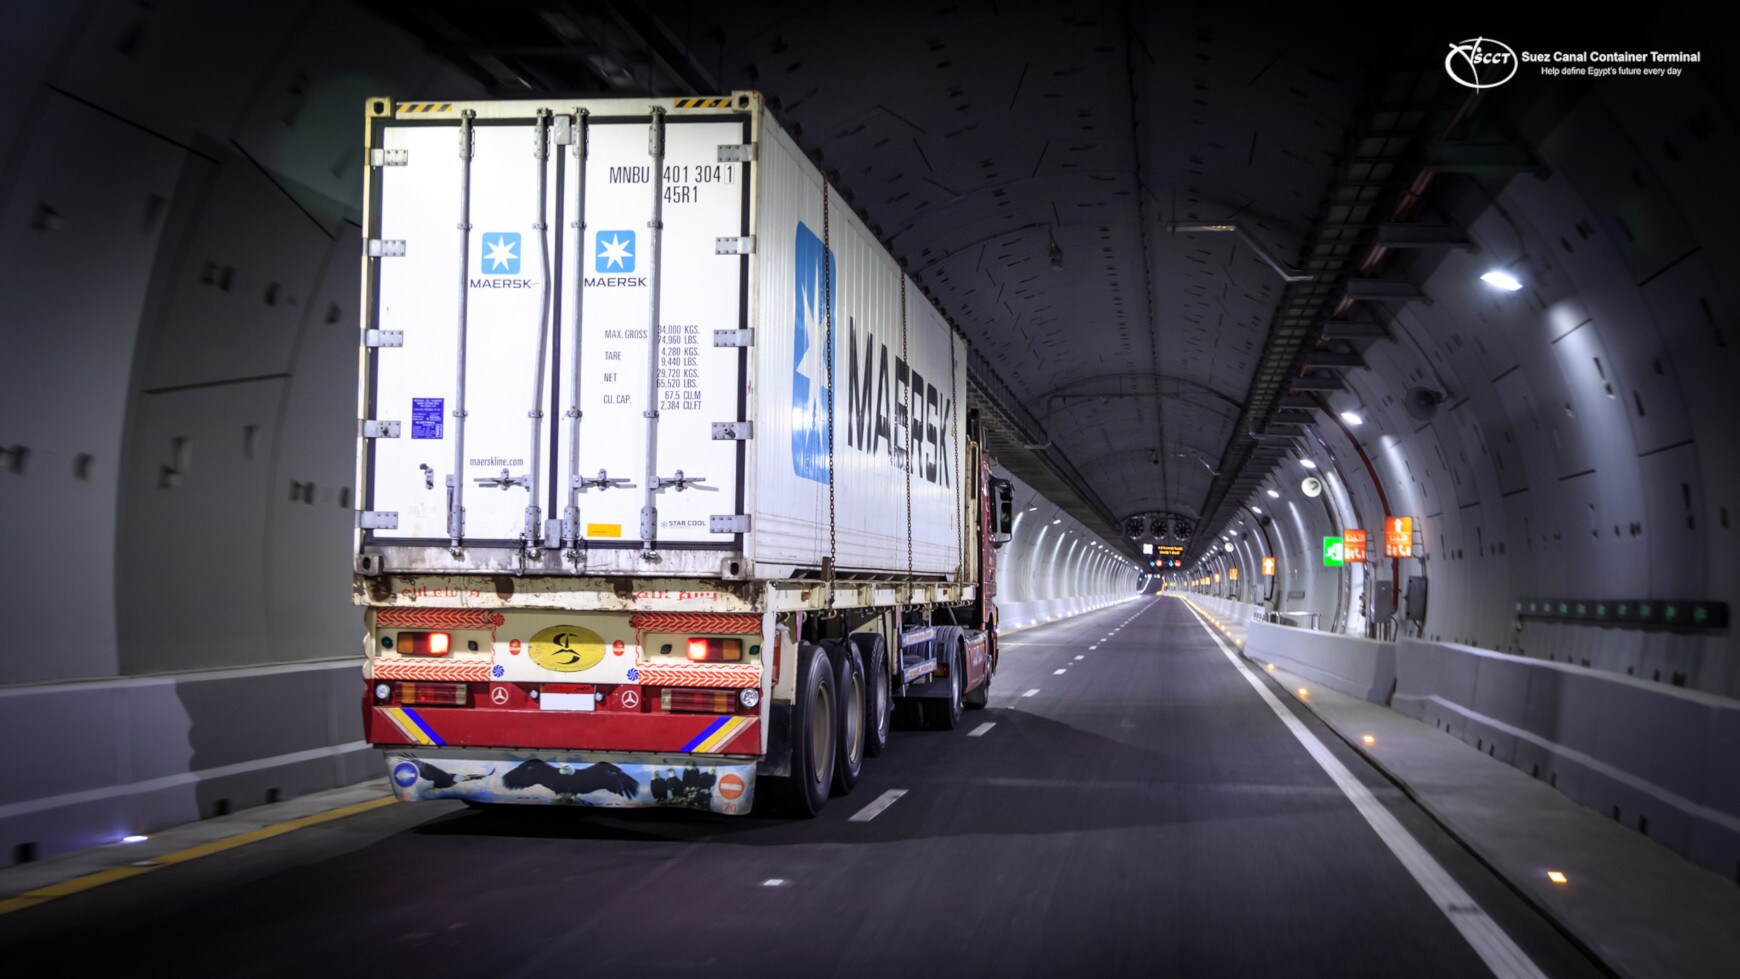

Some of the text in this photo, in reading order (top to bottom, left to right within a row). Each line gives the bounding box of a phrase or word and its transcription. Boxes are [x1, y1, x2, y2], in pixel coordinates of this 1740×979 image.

[609, 166, 650, 184] MNBU
[663, 165, 688, 183] 401
[695, 165, 721, 183] 304
[664, 186, 698, 203] 45R1
[470, 279, 532, 289] MAERSK
[584, 277, 647, 287] MAERSK
[604, 329, 648, 339] MAX. GROSS
[684, 325, 701, 334] KGS.
[684, 335, 699, 344] LBS.
[605, 351, 621, 361] TARE
[683, 347, 700, 356] KGS.
[683, 357, 699, 366] LBS.
[603, 373, 617, 382] NET
[683, 368, 700, 378] KGS.
[683, 379, 698, 388] LBS.
[603, 395, 632, 404] CU. CAP.
[664, 390, 702, 400] 67.5 CU.M
[683, 400, 702, 410] CU.FT
[848, 316, 952, 489] MAERSK
[469, 456, 524, 466] maerskline.com
